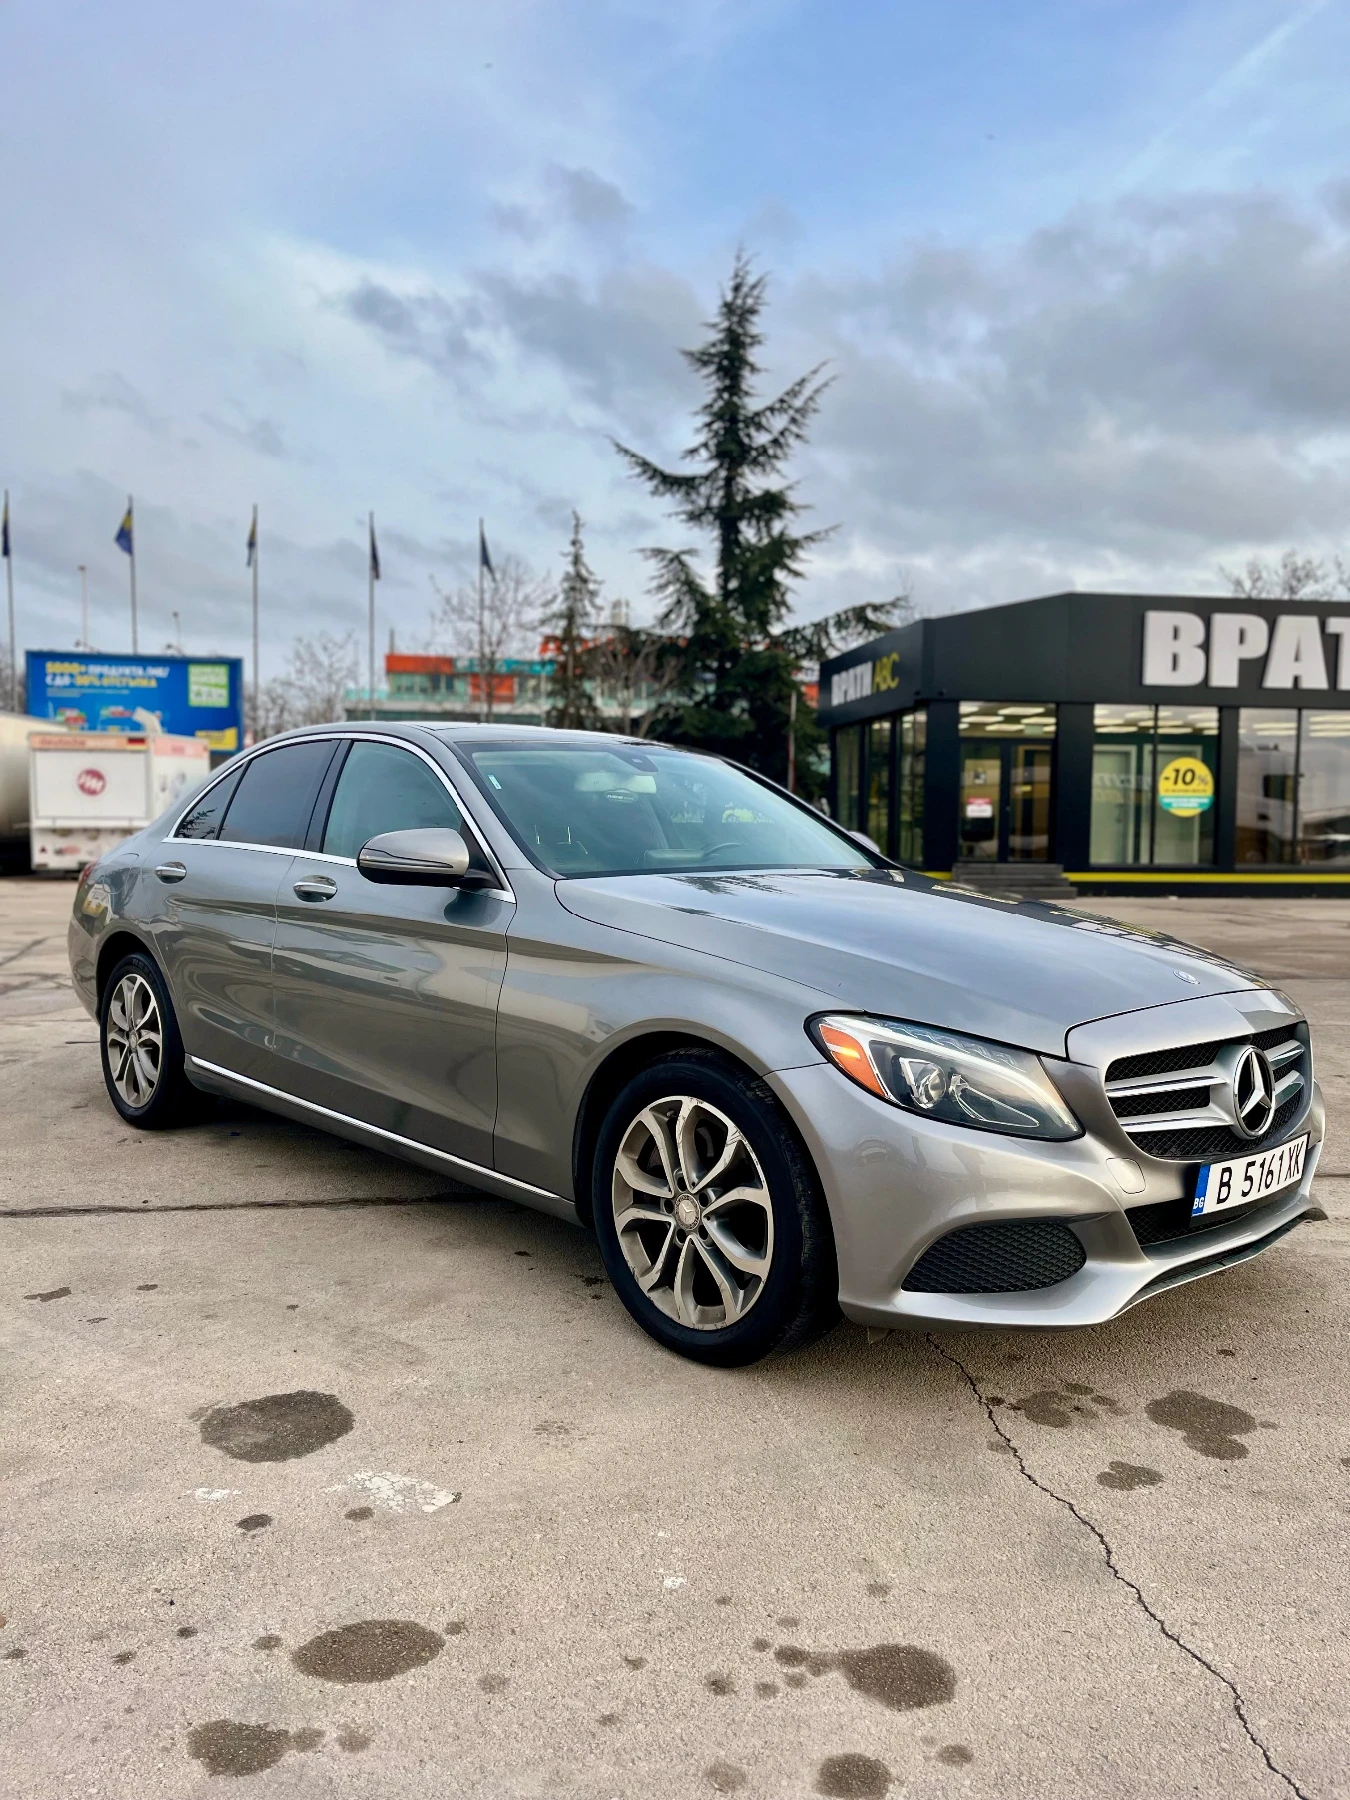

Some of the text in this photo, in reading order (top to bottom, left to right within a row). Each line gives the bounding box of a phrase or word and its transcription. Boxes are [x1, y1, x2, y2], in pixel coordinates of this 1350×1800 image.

[831, 660, 873, 707] ВРАТИ
[1163, 768, 1209, 787] -10%
[1216, 1141, 1304, 1205] B 5161 XK
[1193, 1196, 1205, 1210] BG
